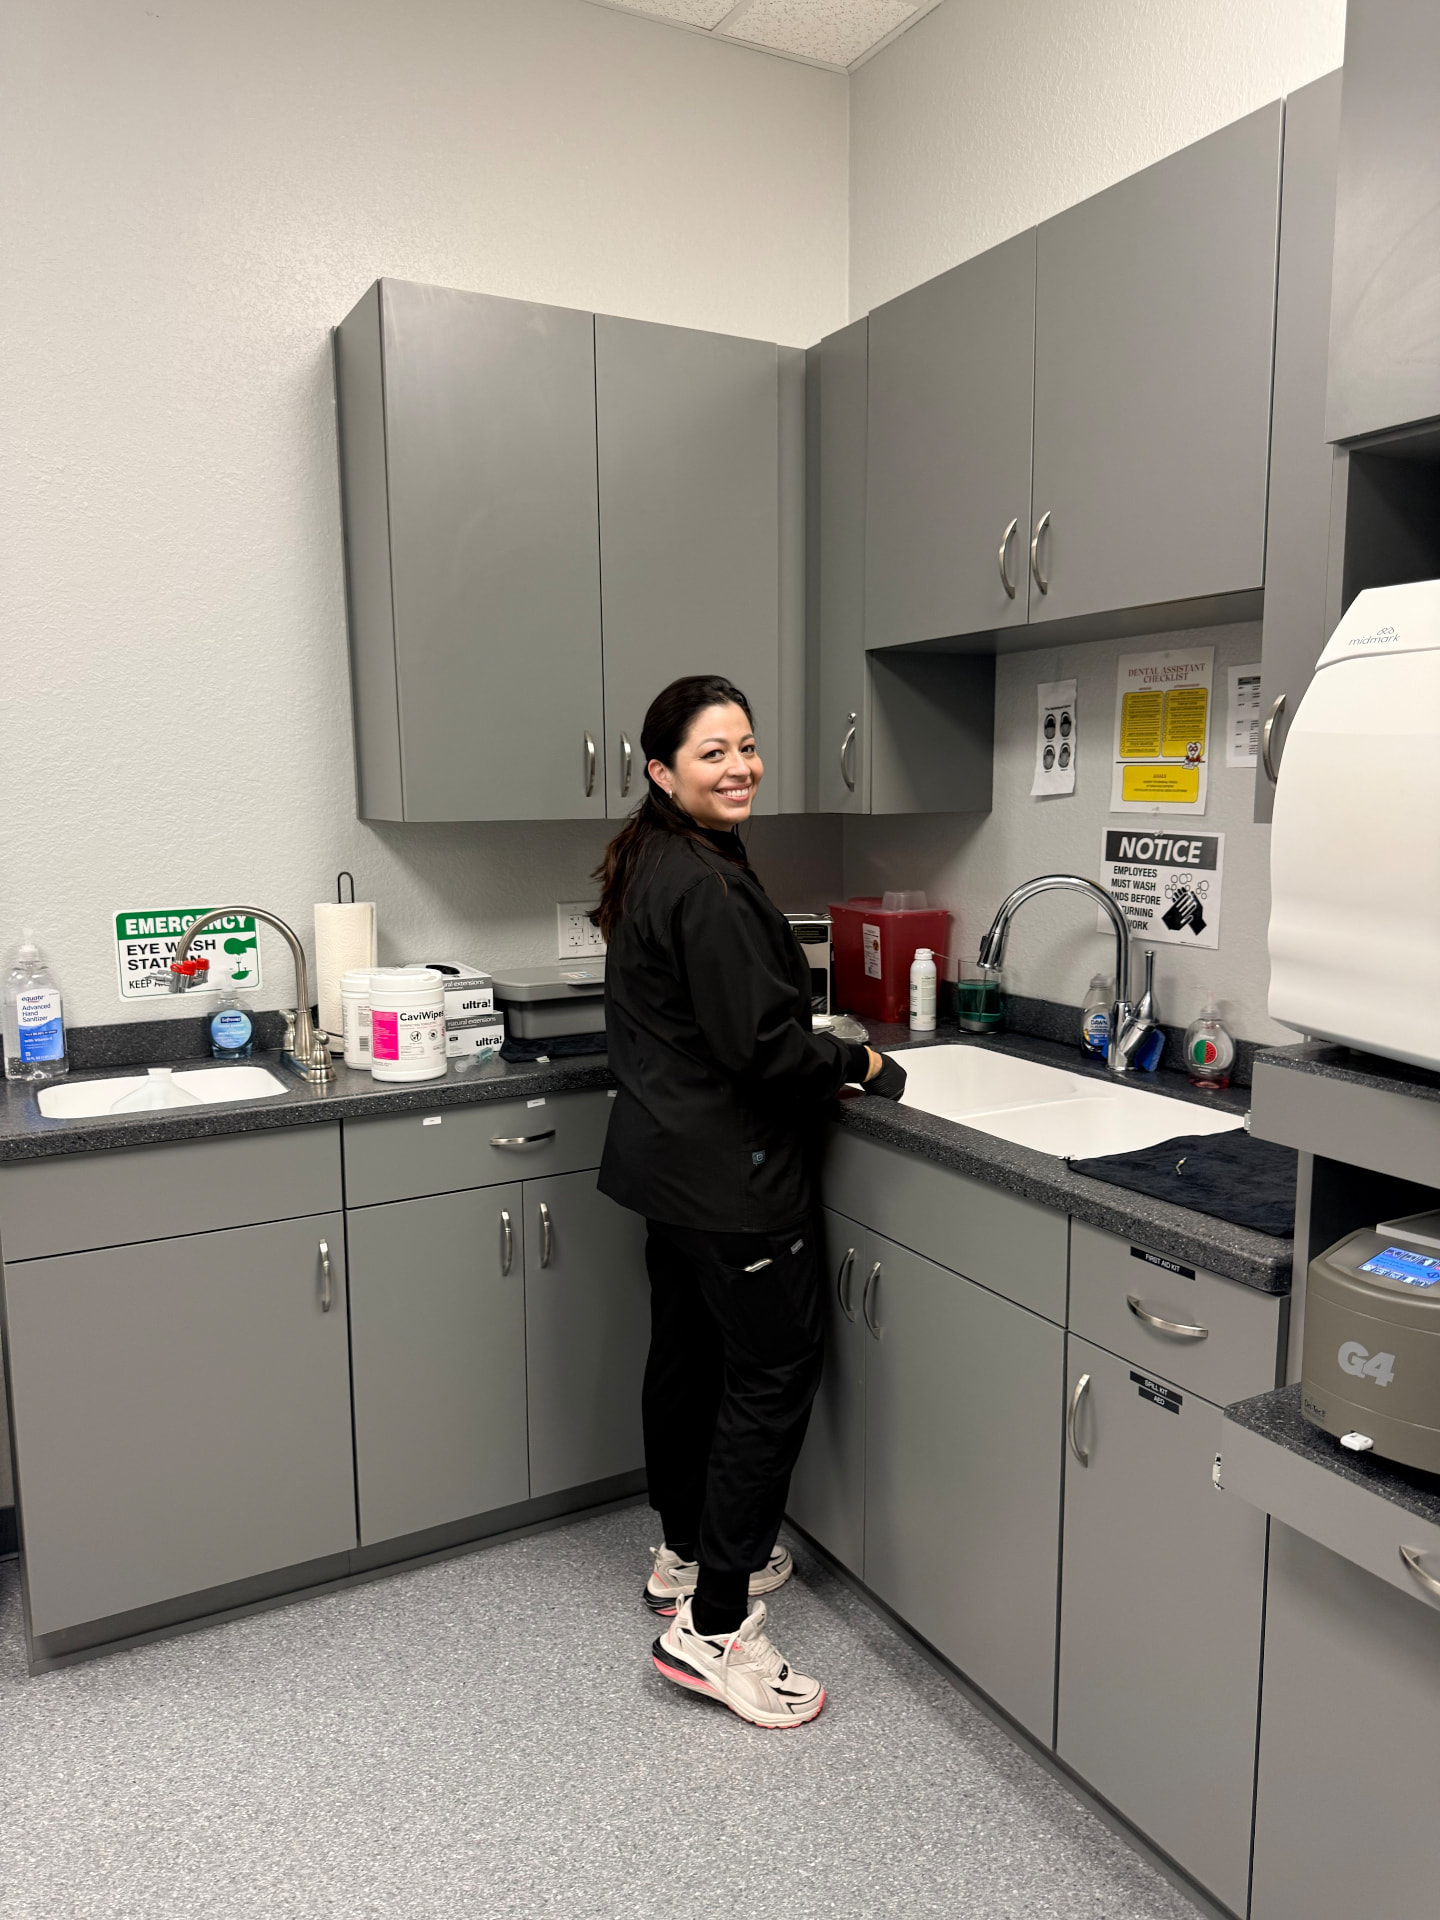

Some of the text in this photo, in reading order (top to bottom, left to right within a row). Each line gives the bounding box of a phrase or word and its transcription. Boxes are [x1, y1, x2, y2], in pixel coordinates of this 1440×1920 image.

[1348, 634, 1400, 646] midmark
[1128, 663, 1206, 677] DENTAL ASSISTANT
[1143, 673, 1189, 683] CHECKLIST
[1119, 836, 1203, 863] NOTICE
[1113, 866, 1158, 878] EMPLOYEES
[1111, 878, 1156, 891] MUST WASH
[1109, 890, 1161, 905] ANDS BEFORE
[1121, 905, 1154, 918] TURNING
[125, 915, 247, 936] EMERGNCY
[126, 939, 217, 956] EYE WSH
[127, 955, 202, 971] STATIN
[129, 979, 152, 989] KEEP
[462, 999, 492, 1010] ultra!
[468, 1017, 496, 1025] extensions
[475, 1036, 502, 1047] ultra!
[1160, 1259, 1171, 1269] AID
[1170, 1264, 1180, 1272] KIT
[1337, 1341, 1396, 1388] G4
